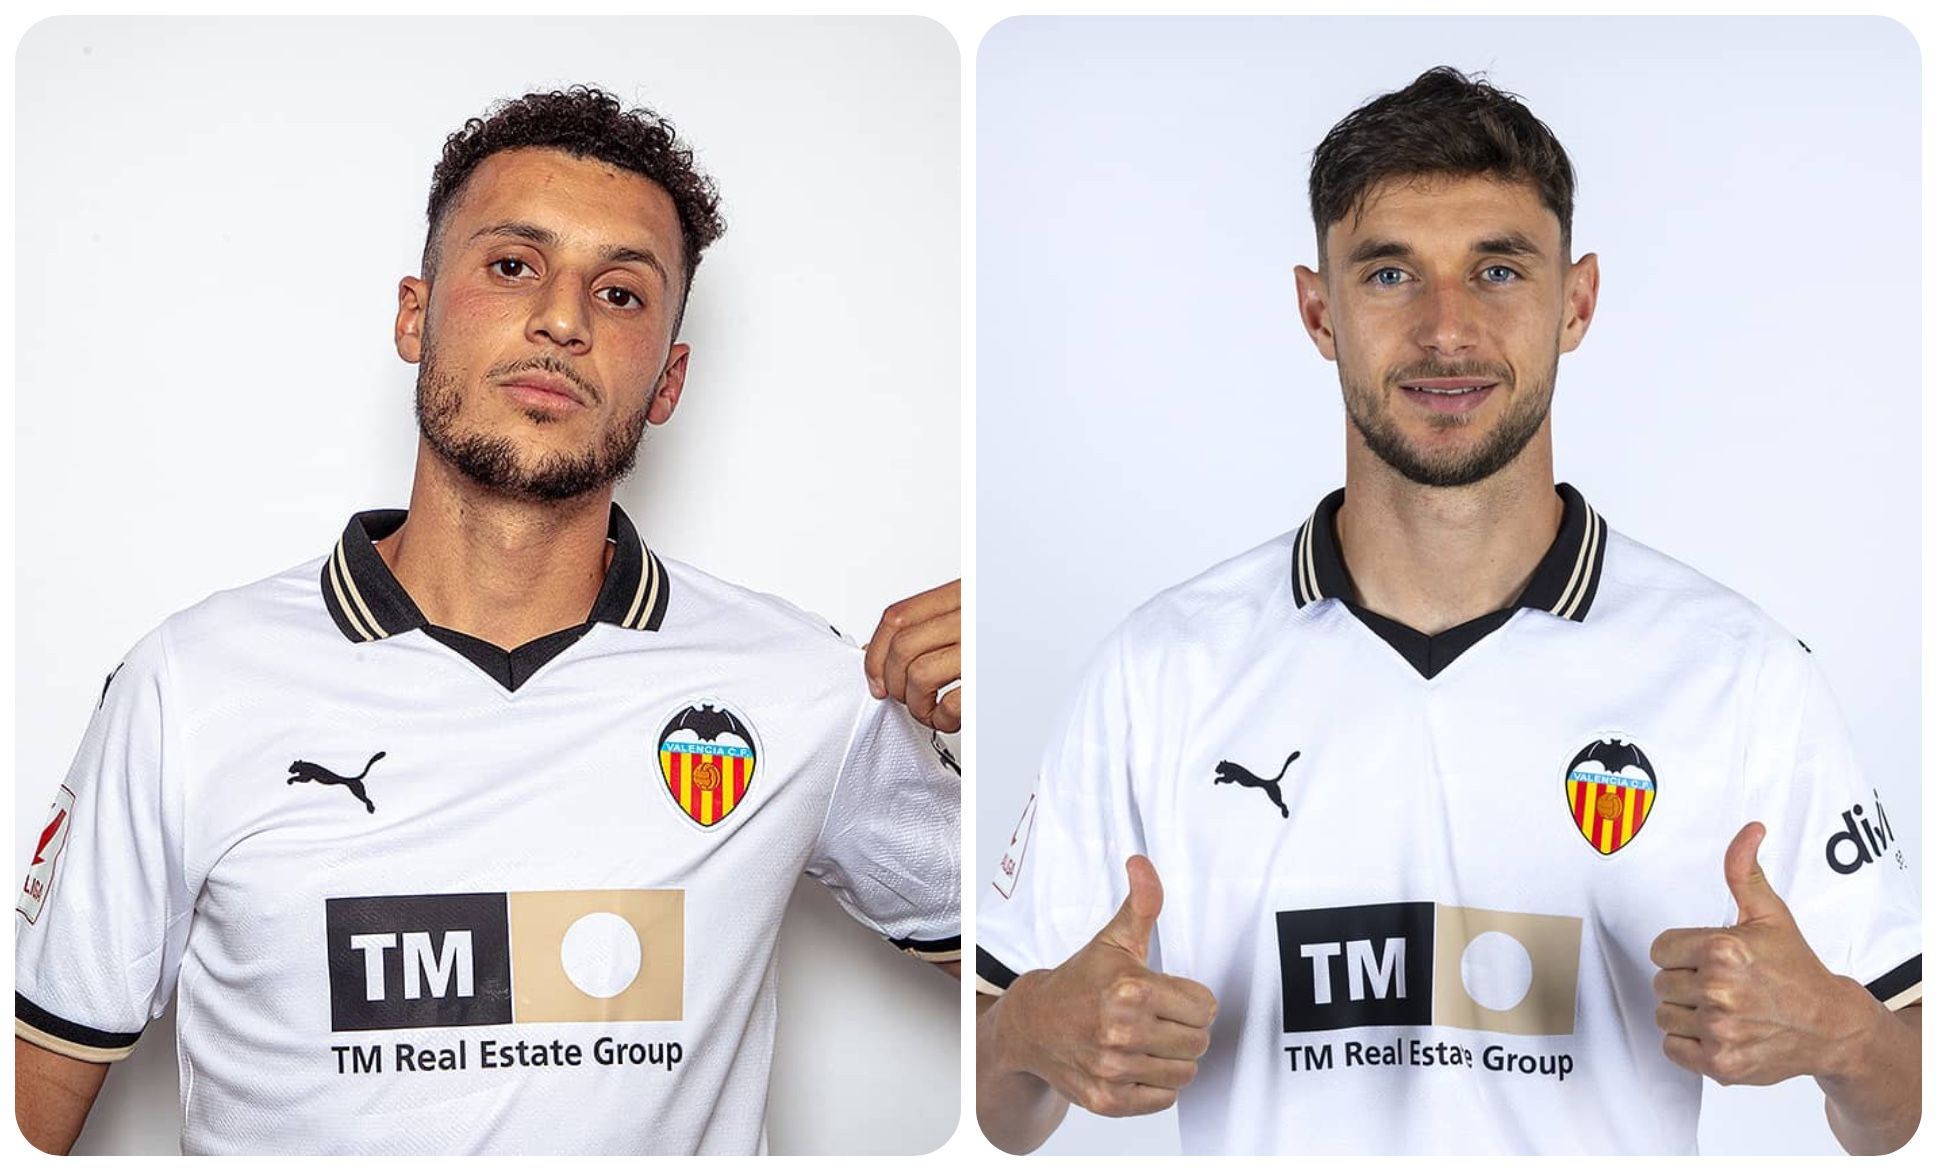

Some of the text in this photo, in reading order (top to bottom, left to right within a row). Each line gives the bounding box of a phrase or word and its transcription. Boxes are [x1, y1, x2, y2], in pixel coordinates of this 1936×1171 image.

[666, 742, 725, 755] VALENCIA
[1574, 772, 1629, 787] VALENCIA
[351, 930, 475, 1001] TM
[1300, 937, 1407, 1005] TM
[331, 1036, 683, 1074] TM Real Estate Group
[1284, 1037, 1574, 1081] TM Real Estae Group
